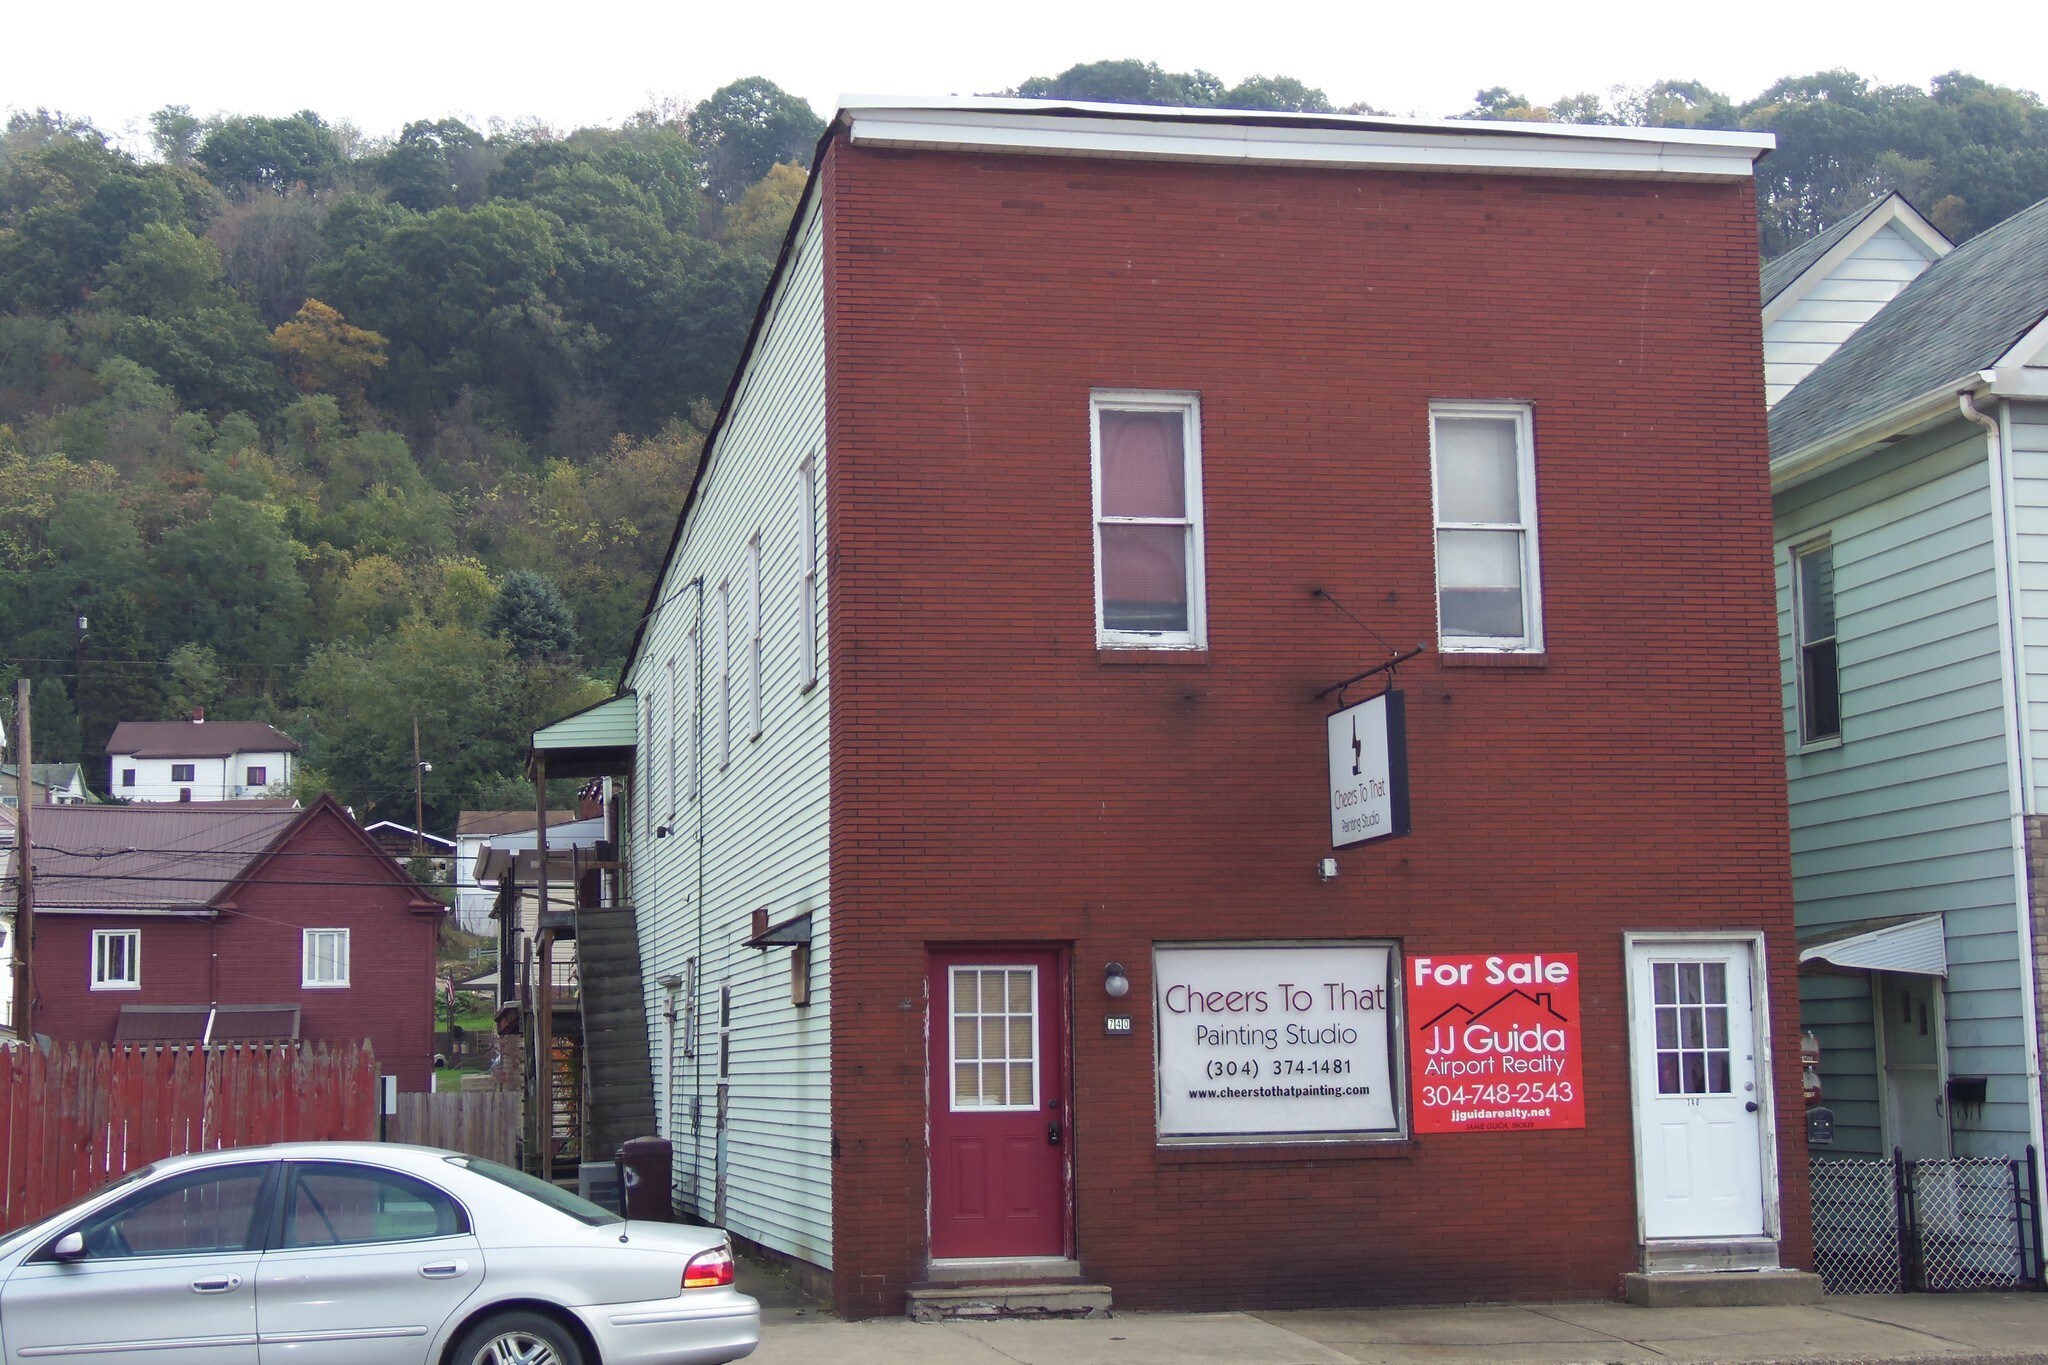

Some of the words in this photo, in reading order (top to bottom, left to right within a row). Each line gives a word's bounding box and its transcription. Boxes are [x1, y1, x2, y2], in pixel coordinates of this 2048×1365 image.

[1335, 790, 1357, 809] Cheers
[1359, 783, 1368, 803] To
[1369, 778, 1385, 800] That
[1342, 817, 1361, 833] Painting
[1362, 811, 1379, 828] Studio
[1414, 958, 1473, 986] For
[1485, 955, 1570, 985] Sale
[1165, 984, 1268, 1014] Cheers
[1278, 983, 1313, 1012] To
[1324, 982, 1386, 1011] That
[1108, 1019, 1129, 1029] 740
[1197, 1024, 1278, 1050] Painting
[1286, 1022, 1358, 1046] Studio
[1425, 1025, 1455, 1055] JJ
[1463, 1023, 1566, 1054] Guida
[1206, 1059, 1259, 1080] (304)
[1273, 1059, 1352, 1076] 374-1481
[1424, 1056, 1495, 1078] Airport
[1502, 1054, 1566, 1076] Realty
[1189, 1084, 1370, 1099] www.cheerstothatpainting.com
[1422, 1081, 1574, 1107] 304-748-2543
[1451, 1107, 1551, 1122] jjguidarealty.net
[1512, 1121, 1535, 1129] BROKER
